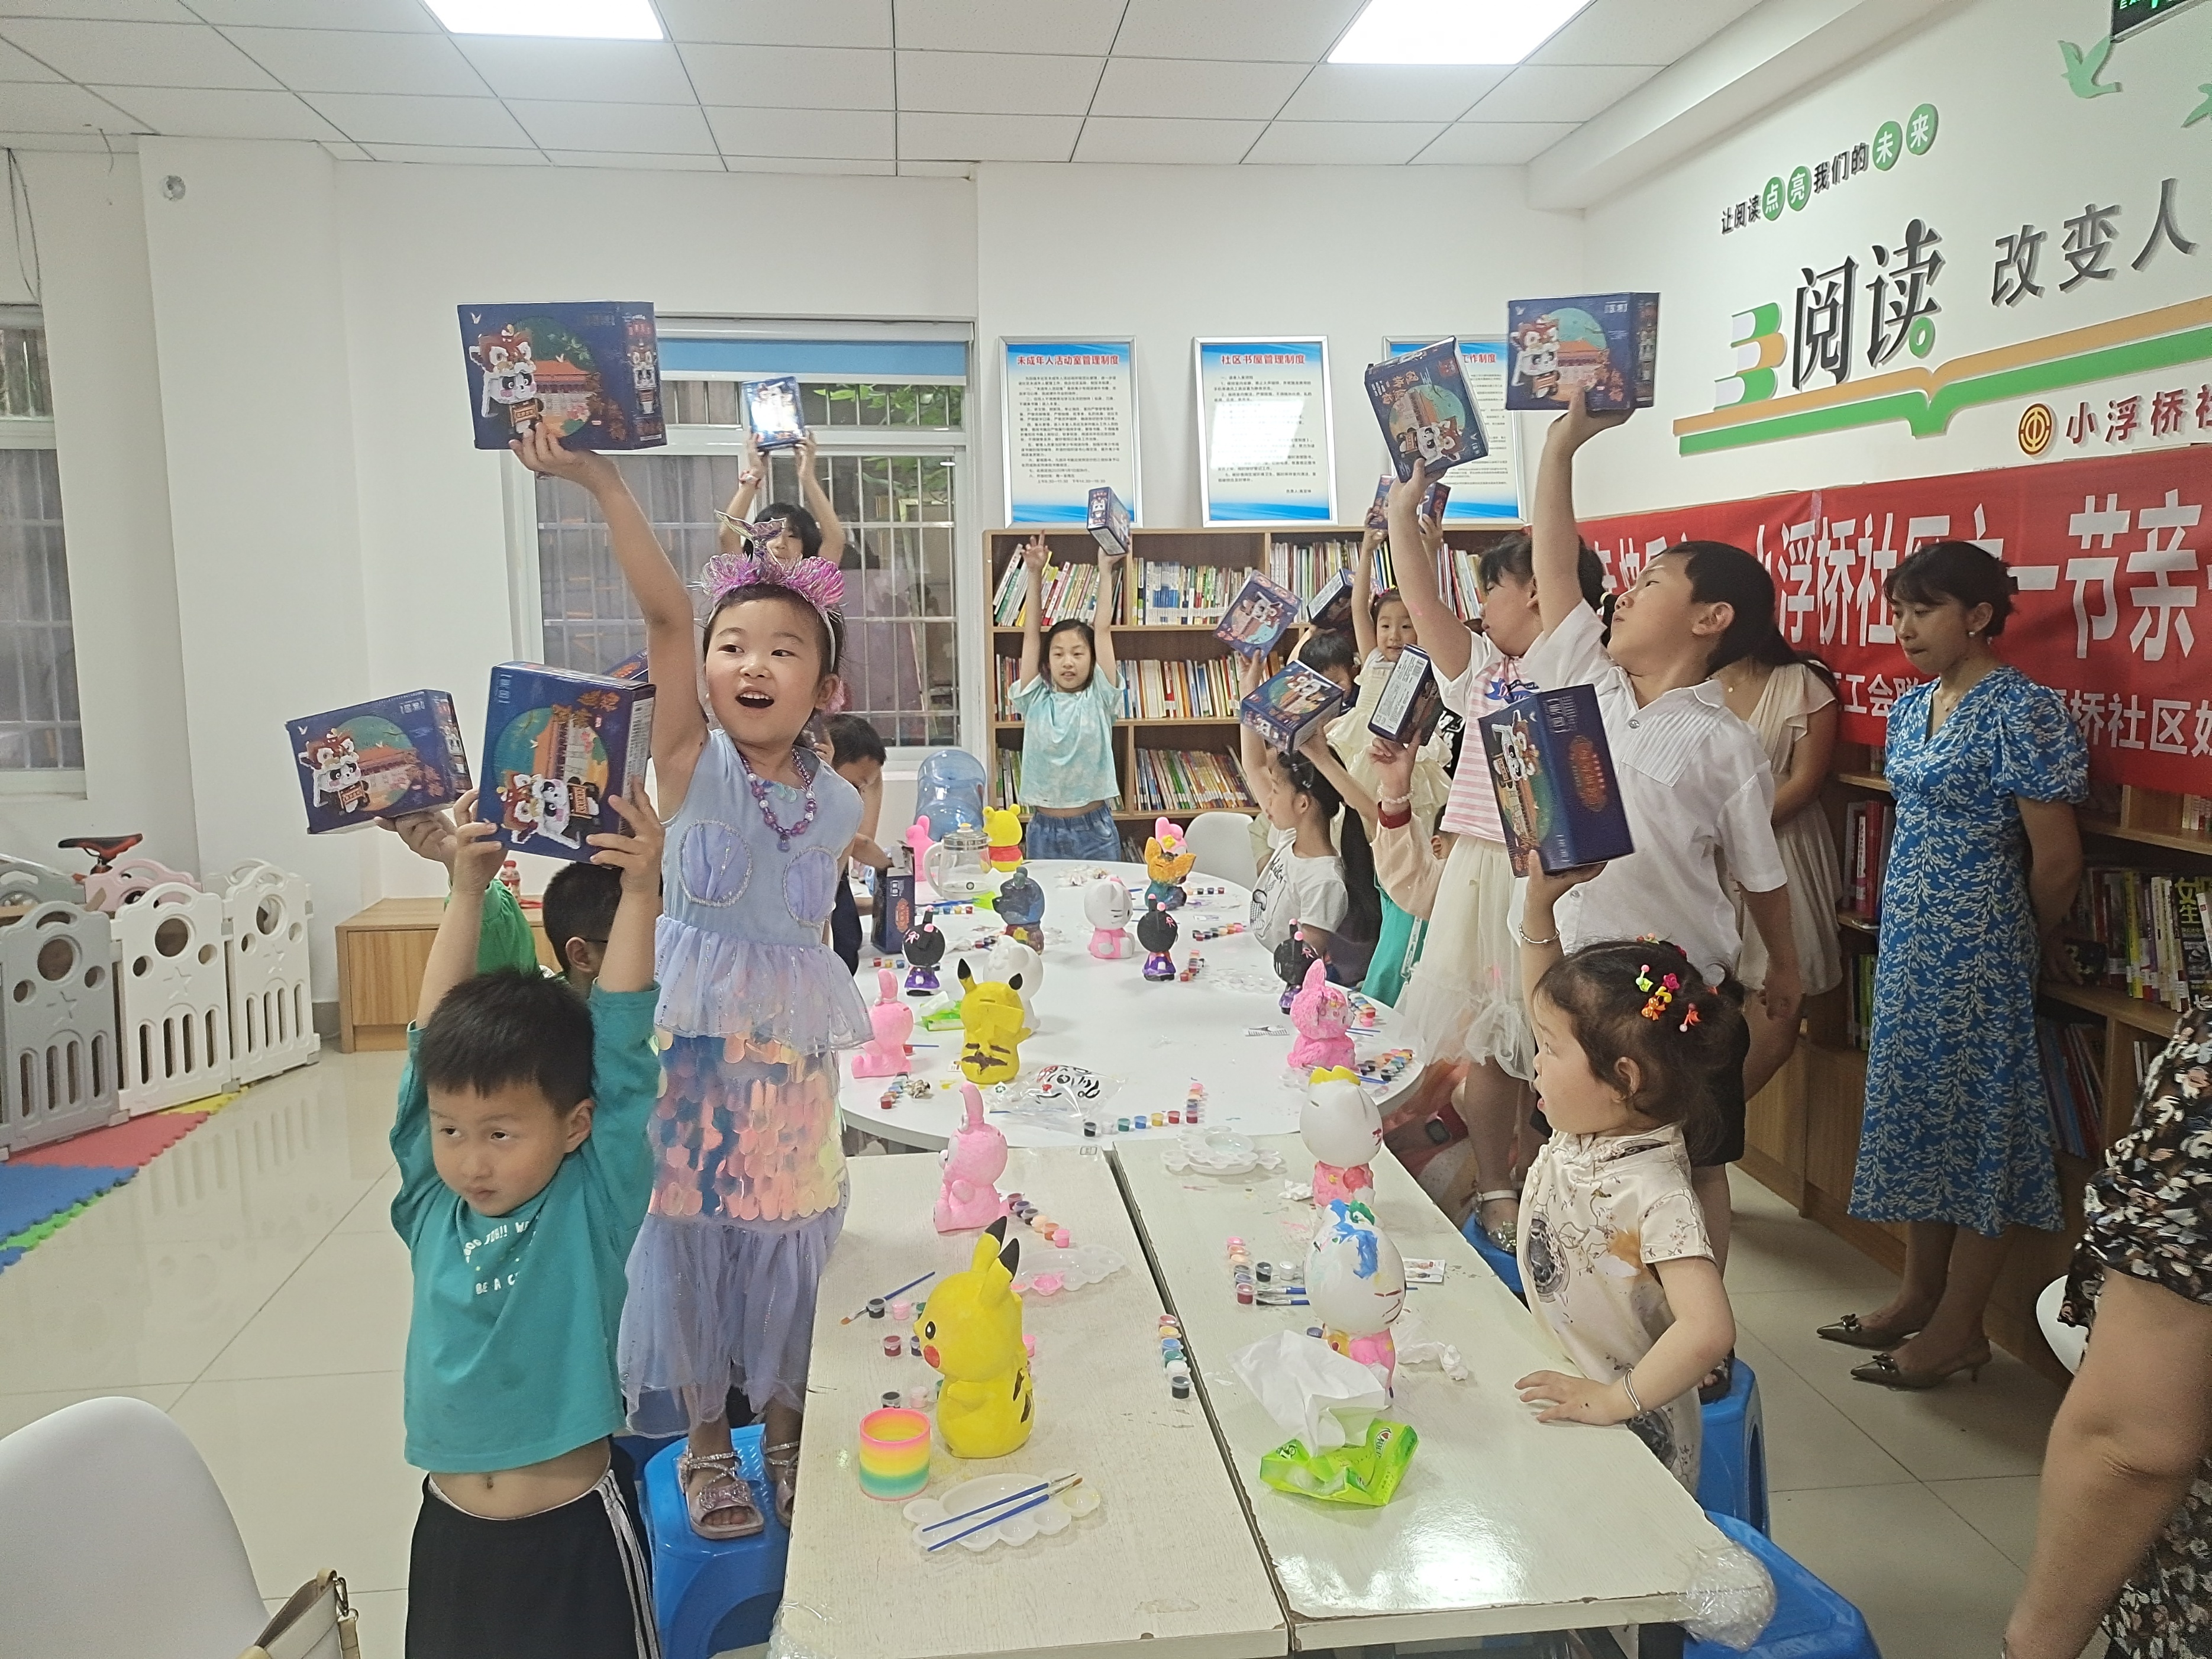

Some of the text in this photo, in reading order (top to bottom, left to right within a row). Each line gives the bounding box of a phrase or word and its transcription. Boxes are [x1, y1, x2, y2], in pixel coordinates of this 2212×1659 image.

[1720, 112, 1932, 235] 让阅读点亮我们的未来
[1793, 177, 2197, 390] 阅读 改变人
[1017, 355, 1120, 366] 未成年人活动室管理制度
[1221, 354, 1306, 365] 社区书屋管理制度
